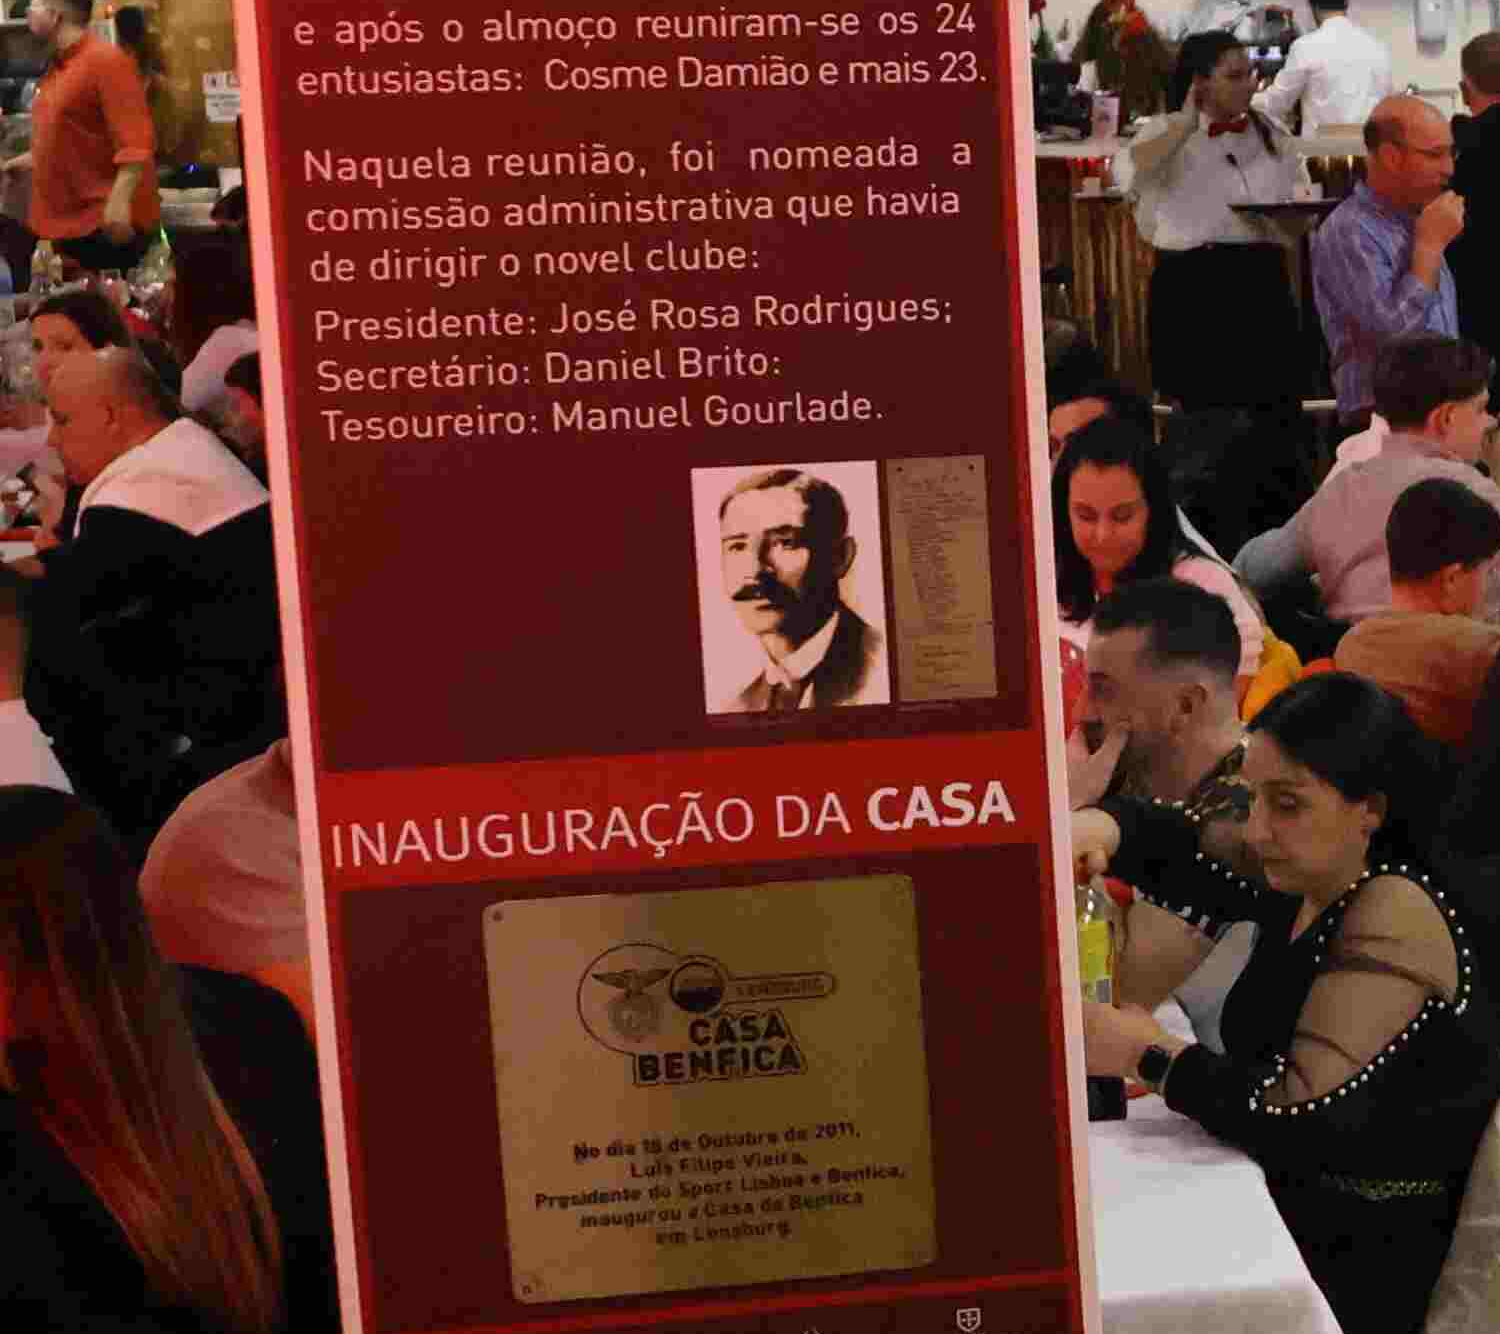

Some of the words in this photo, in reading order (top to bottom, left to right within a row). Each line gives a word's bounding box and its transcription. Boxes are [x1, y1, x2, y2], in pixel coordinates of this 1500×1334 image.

[294, 22, 314, 44] e
[336, 11, 424, 52] após
[443, 20, 463, 42] o
[484, 10, 616, 48] almoço
[637, 7, 859, 38] reuniram-se
[880, 12, 918, 34] os
[936, 3, 975, 33] 24
[298, 62, 522, 95] entusiastas:
[545, 59, 667, 90] Cosme
[679, 55, 809, 87] Damião
[819, 63, 838, 85] e
[849, 53, 930, 83] mais
[939, 51, 986, 82] 23.
[304, 147, 470, 188] Naquela
[488, 144, 645, 177] reunião,
[670, 141, 712, 171] foi
[750, 137, 917, 170] nomeada
[953, 143, 970, 165] a
[307, 198, 489, 231] comissão
[505, 192, 773, 226] administrativa
[787, 195, 852, 225] que
[868, 184, 960, 215] havia
[311, 251, 354, 281] de
[370, 247, 487, 287] dirigir
[500, 254, 520, 275] o
[535, 242, 634, 275] novel
[646, 239, 758, 271] clube:
[315, 307, 536, 341] Presidente:
[550, 299, 636, 333] José
[651, 299, 739, 329] Rosa
[755, 293, 950, 331] Rodrigues;
[317, 355, 529, 391] Secretário:
[546, 349, 665, 383] Daniel
[320, 405, 537, 441] Tesoureiro:
[553, 397, 691, 431] Manuel
[705, 391, 882, 425] Gourlade.
[333, 792, 753, 867] INAUGURAÇÃO
[776, 792, 851, 837] DA
[868, 781, 1016, 830] CASA
[690, 1016, 786, 1046] CASA
[639, 1044, 800, 1081] BENFICA
